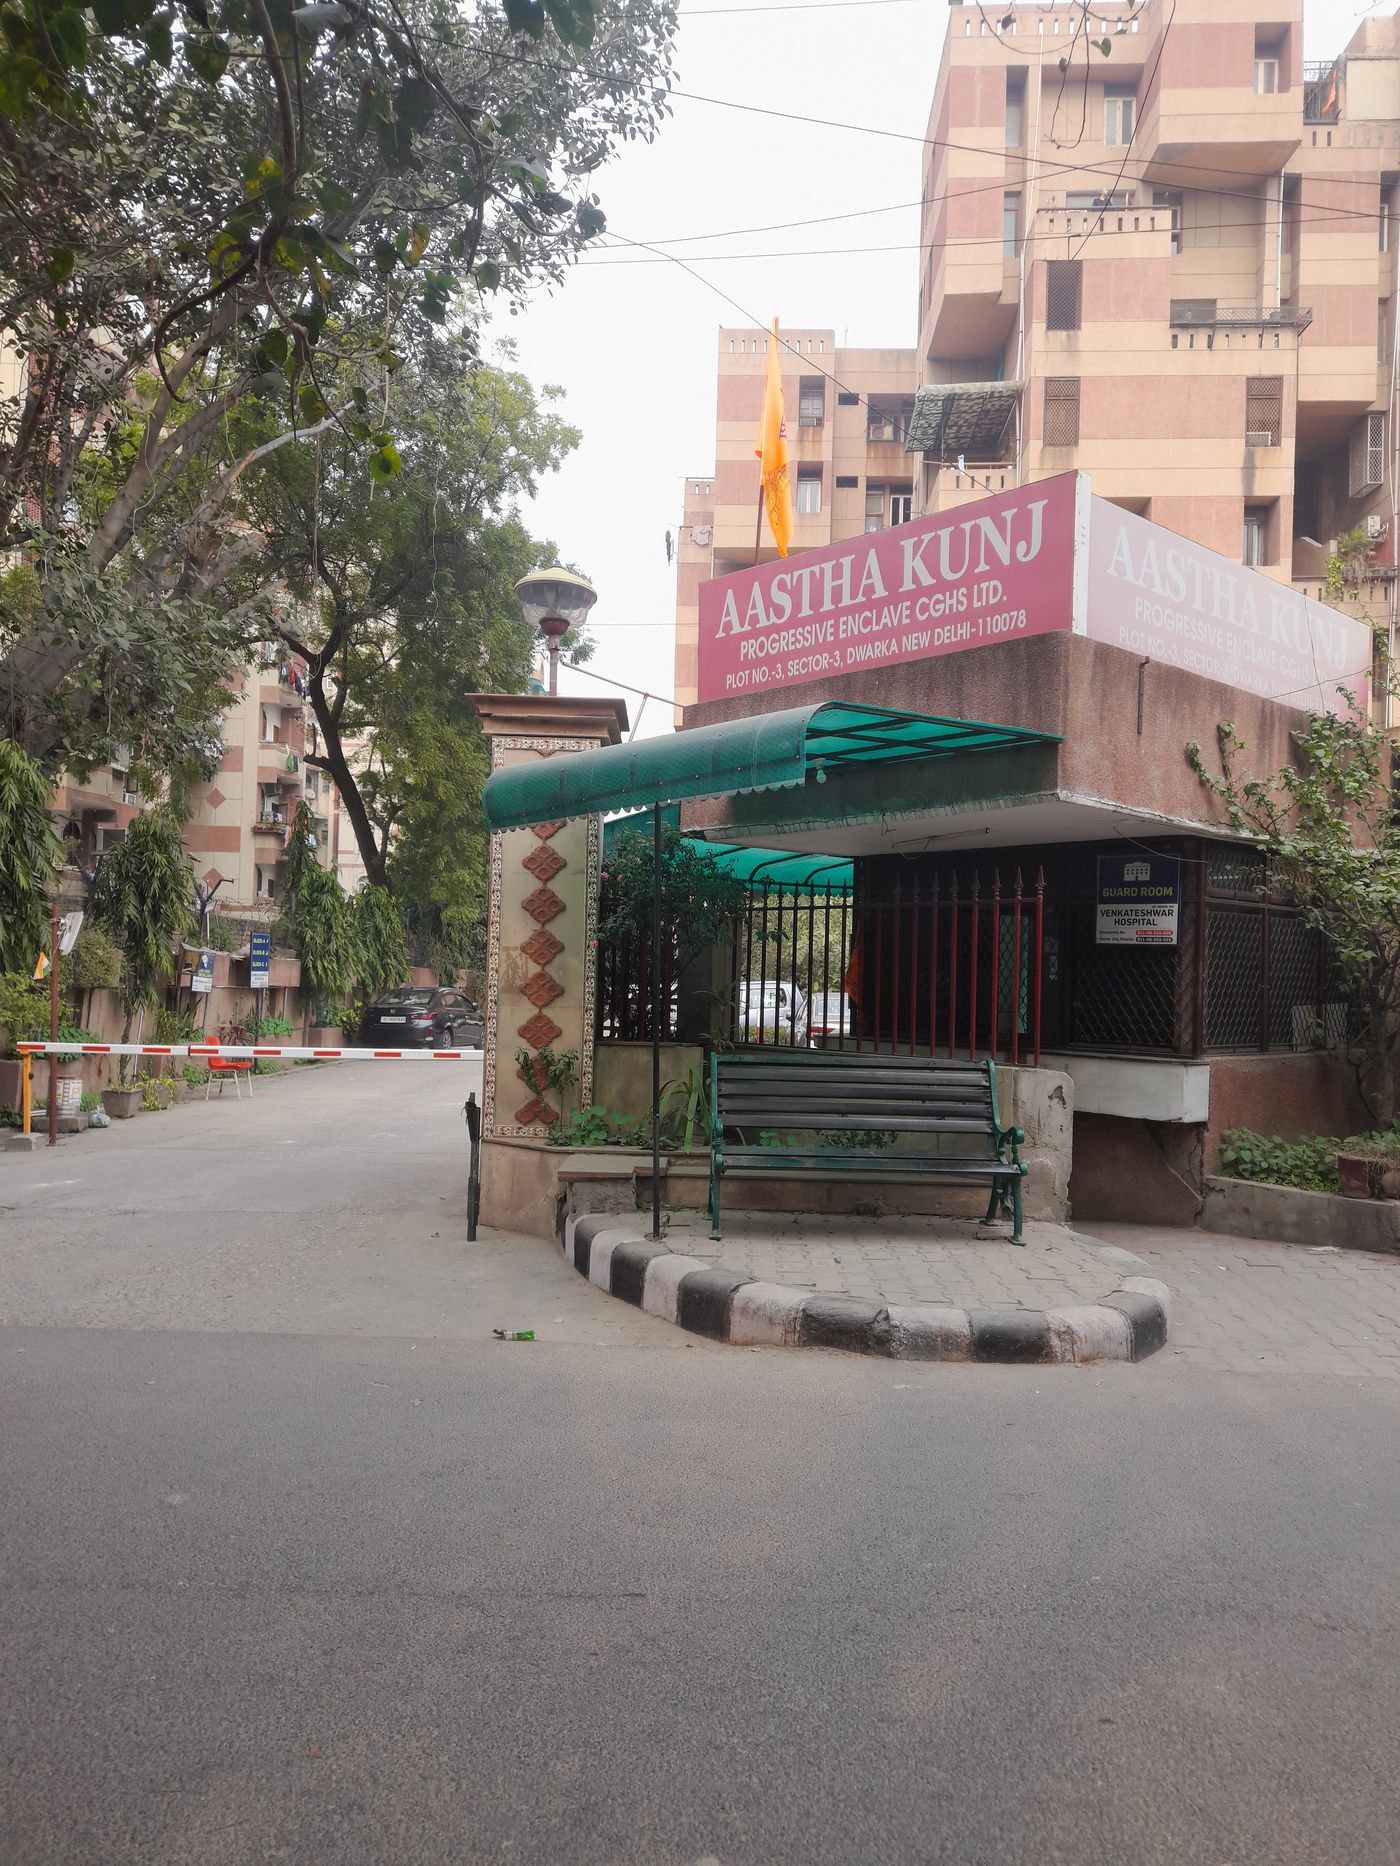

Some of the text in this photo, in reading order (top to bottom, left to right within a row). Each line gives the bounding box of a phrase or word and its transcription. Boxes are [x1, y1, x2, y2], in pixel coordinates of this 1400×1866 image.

[715, 500, 1049, 639] AASTHA KUNJ
[1106, 525, 1349, 670] AASTHA KUNJ
[726, 669, 750, 690] PLOT
[788, 650, 843, 677] SECTOR-3,
[847, 637, 898, 664] DWARKA
[902, 629, 931, 652] NEW
[934, 609, 1027, 646] DELHI-110078
[740, 580, 1008, 661] PROGRESSIVE ENCLAVE CGHS LTD.
[1119, 625, 1146, 648] PLOT
[1135, 597, 1223, 649] PROGRESSIVE
[1227, 633, 1278, 671] ENCLAVE
[1100, 909, 1174, 917] VENKATESHWAR
[1103, 886, 1173, 897] GUARD ROOM
[1114, 918, 1158, 926] HOSPITAL
